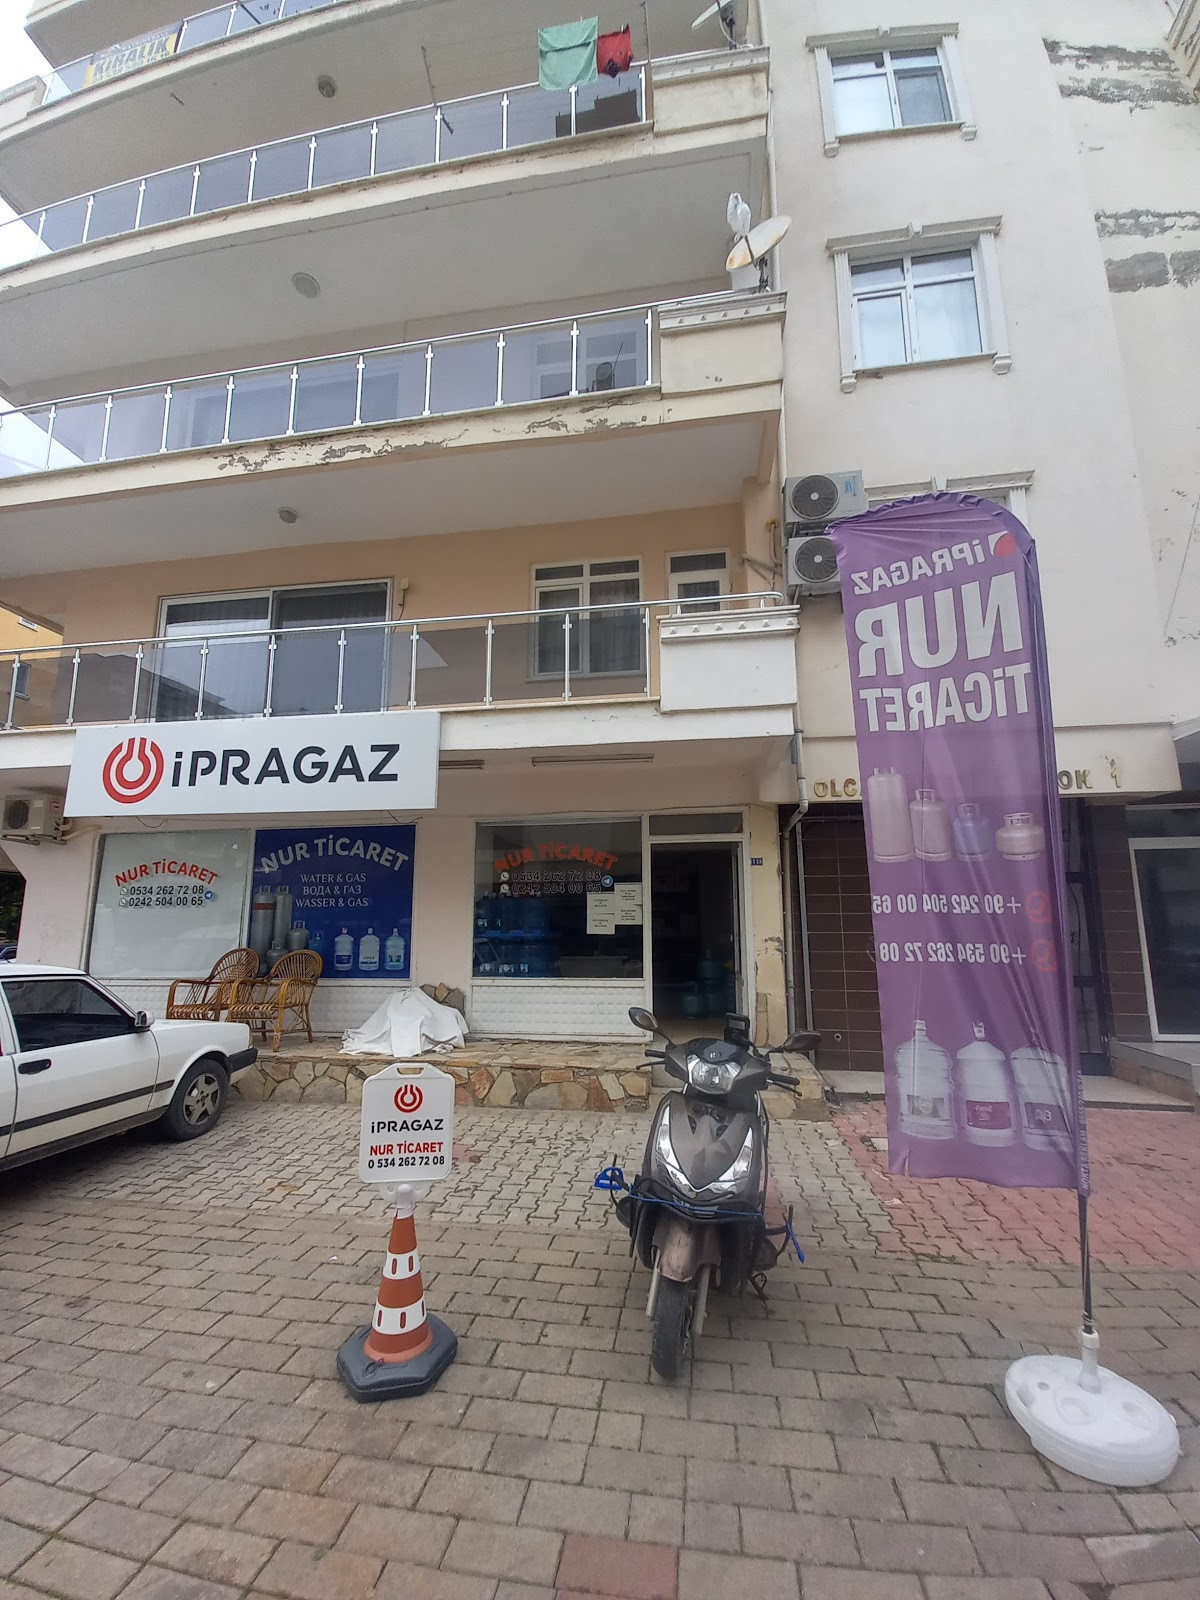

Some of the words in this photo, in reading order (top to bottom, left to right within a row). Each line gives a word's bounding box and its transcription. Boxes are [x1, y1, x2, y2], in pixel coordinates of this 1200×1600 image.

[814, 778, 862, 797] OLC
[259, 842, 310, 874] NUR
[494, 847, 534, 873] NUR
[114, 864, 150, 887] NUR
[300, 873, 334, 883] WATER
[336, 873, 343, 882] &
[345, 873, 367, 882] GAS
[512, 870, 540, 881] 0534
[568, 870, 583, 881] 72
[585, 870, 601, 881] 08
[130, 886, 153, 896] 0534
[156, 885, 174, 895] 262
[177, 885, 189, 895] 72
[192, 885, 204, 895] 08
[303, 885, 332, 897] ВОДА
[334, 885, 341, 895] &
[343, 885, 362, 895] ГАЗ
[567, 882, 583, 894] 00
[585, 882, 601, 893] 65
[129, 897, 153, 907] 0242
[155, 896, 173, 906] 504
[176, 896, 188, 906] 00
[191, 896, 203, 906] 65
[296, 898, 336, 908] WASSER
[337, 898, 345, 907] &
[347, 897, 369, 907] GAS
[370, 1144, 394, 1156] NUR
[368, 1160, 375, 1169] 0
[377, 1158, 396, 1168] 534
[398, 1156, 416, 1167] 262
[418, 1156, 430, 1166] 72
[432, 1155, 445, 1165] 08
